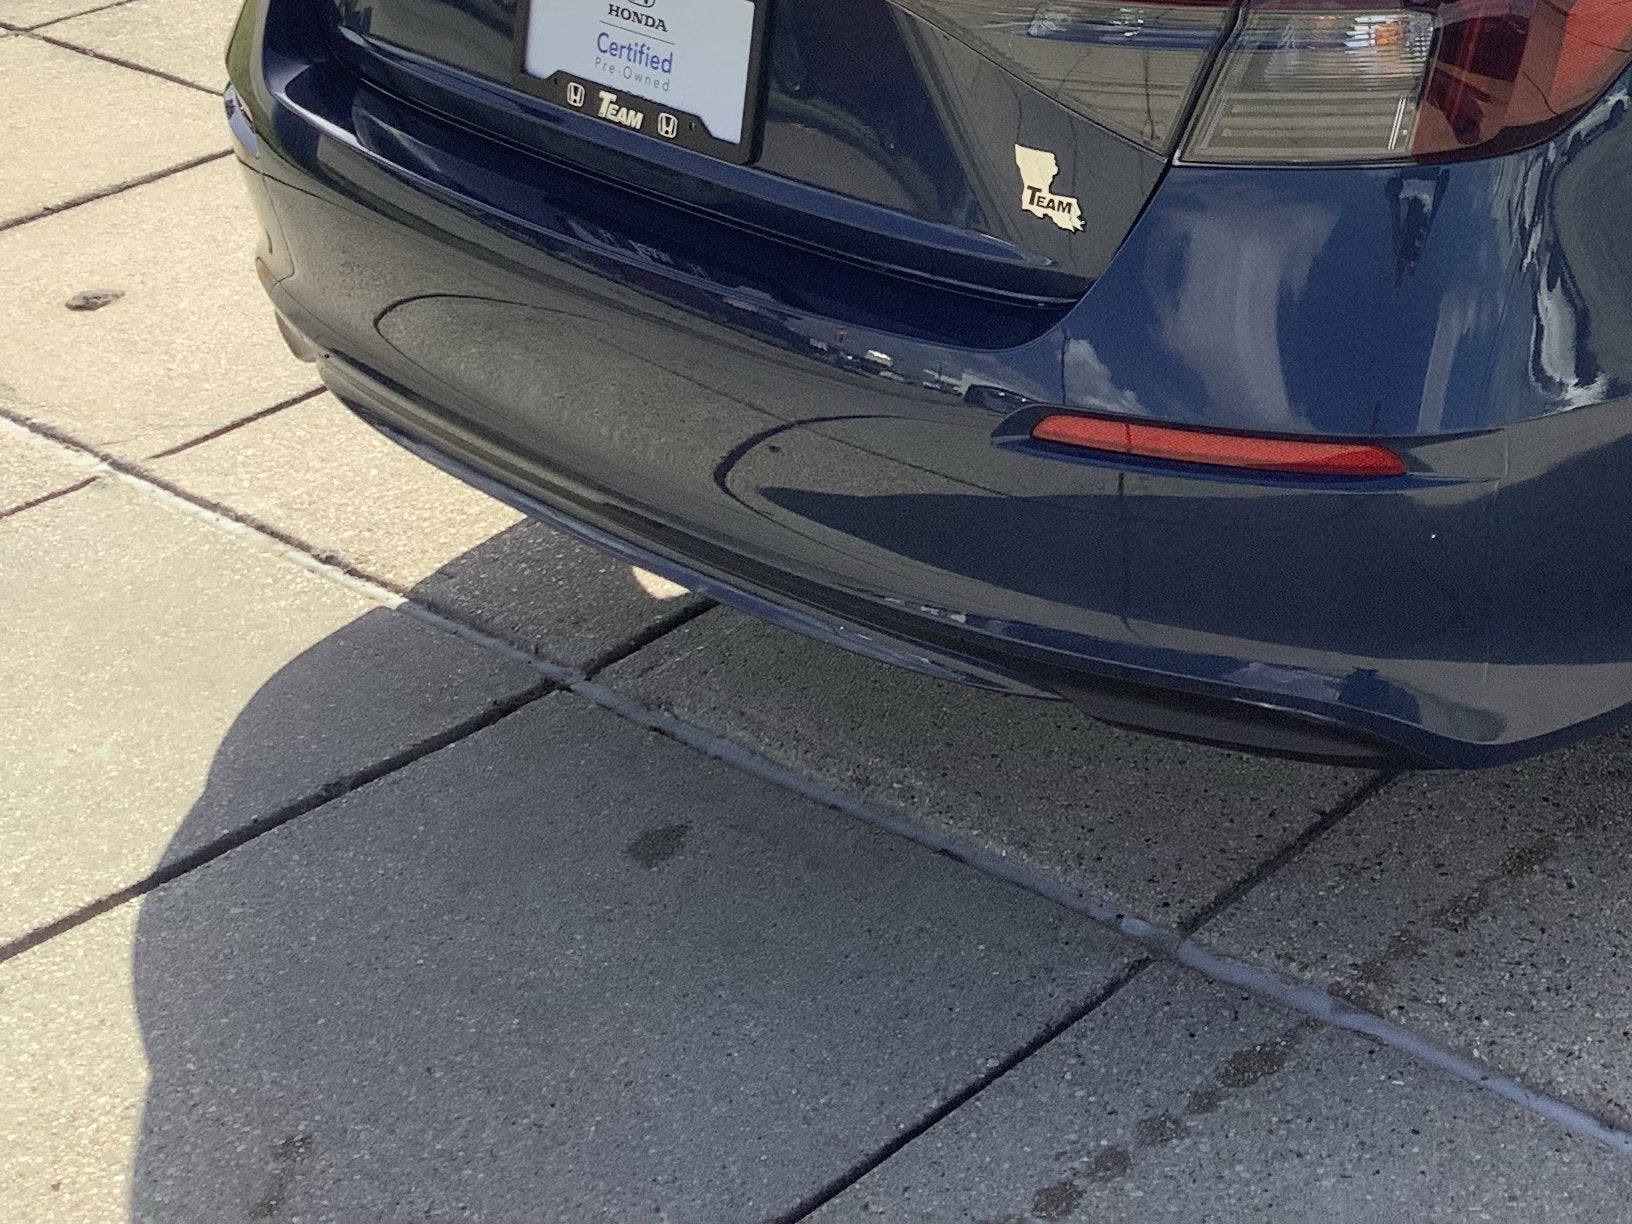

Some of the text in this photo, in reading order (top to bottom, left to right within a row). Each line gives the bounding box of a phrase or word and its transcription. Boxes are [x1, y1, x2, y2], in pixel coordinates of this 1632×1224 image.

[607, 3, 668, 33] HONDA
[596, 32, 674, 74] Certified
[593, 56, 671, 92] Pre-Owned
